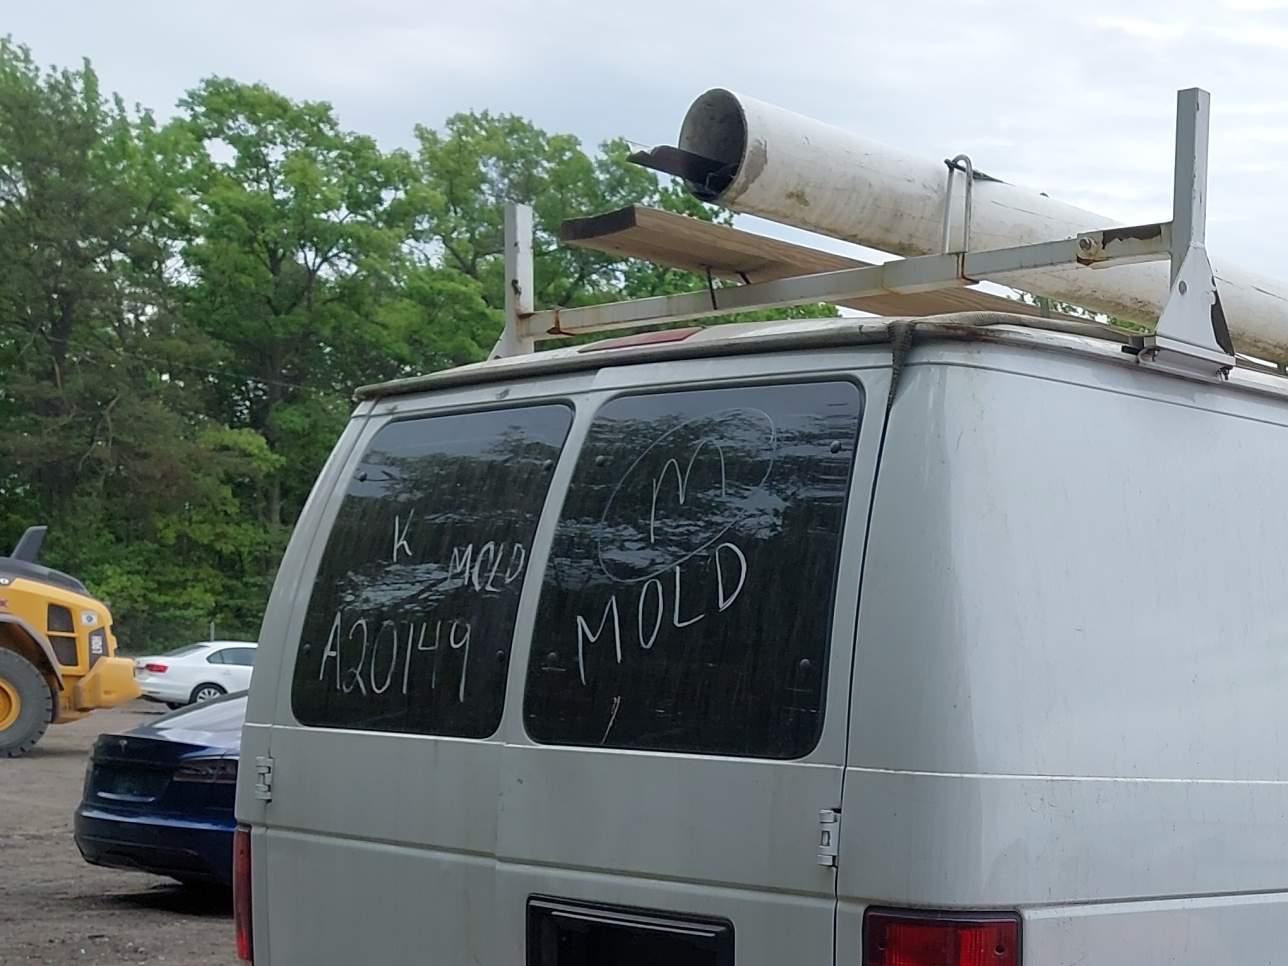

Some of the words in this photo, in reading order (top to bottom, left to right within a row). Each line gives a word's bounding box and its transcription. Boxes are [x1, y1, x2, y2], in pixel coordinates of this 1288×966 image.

[391, 508, 413, 562] K
[319, 610, 471, 703] A20149
[575, 542, 748, 685] MOLD
